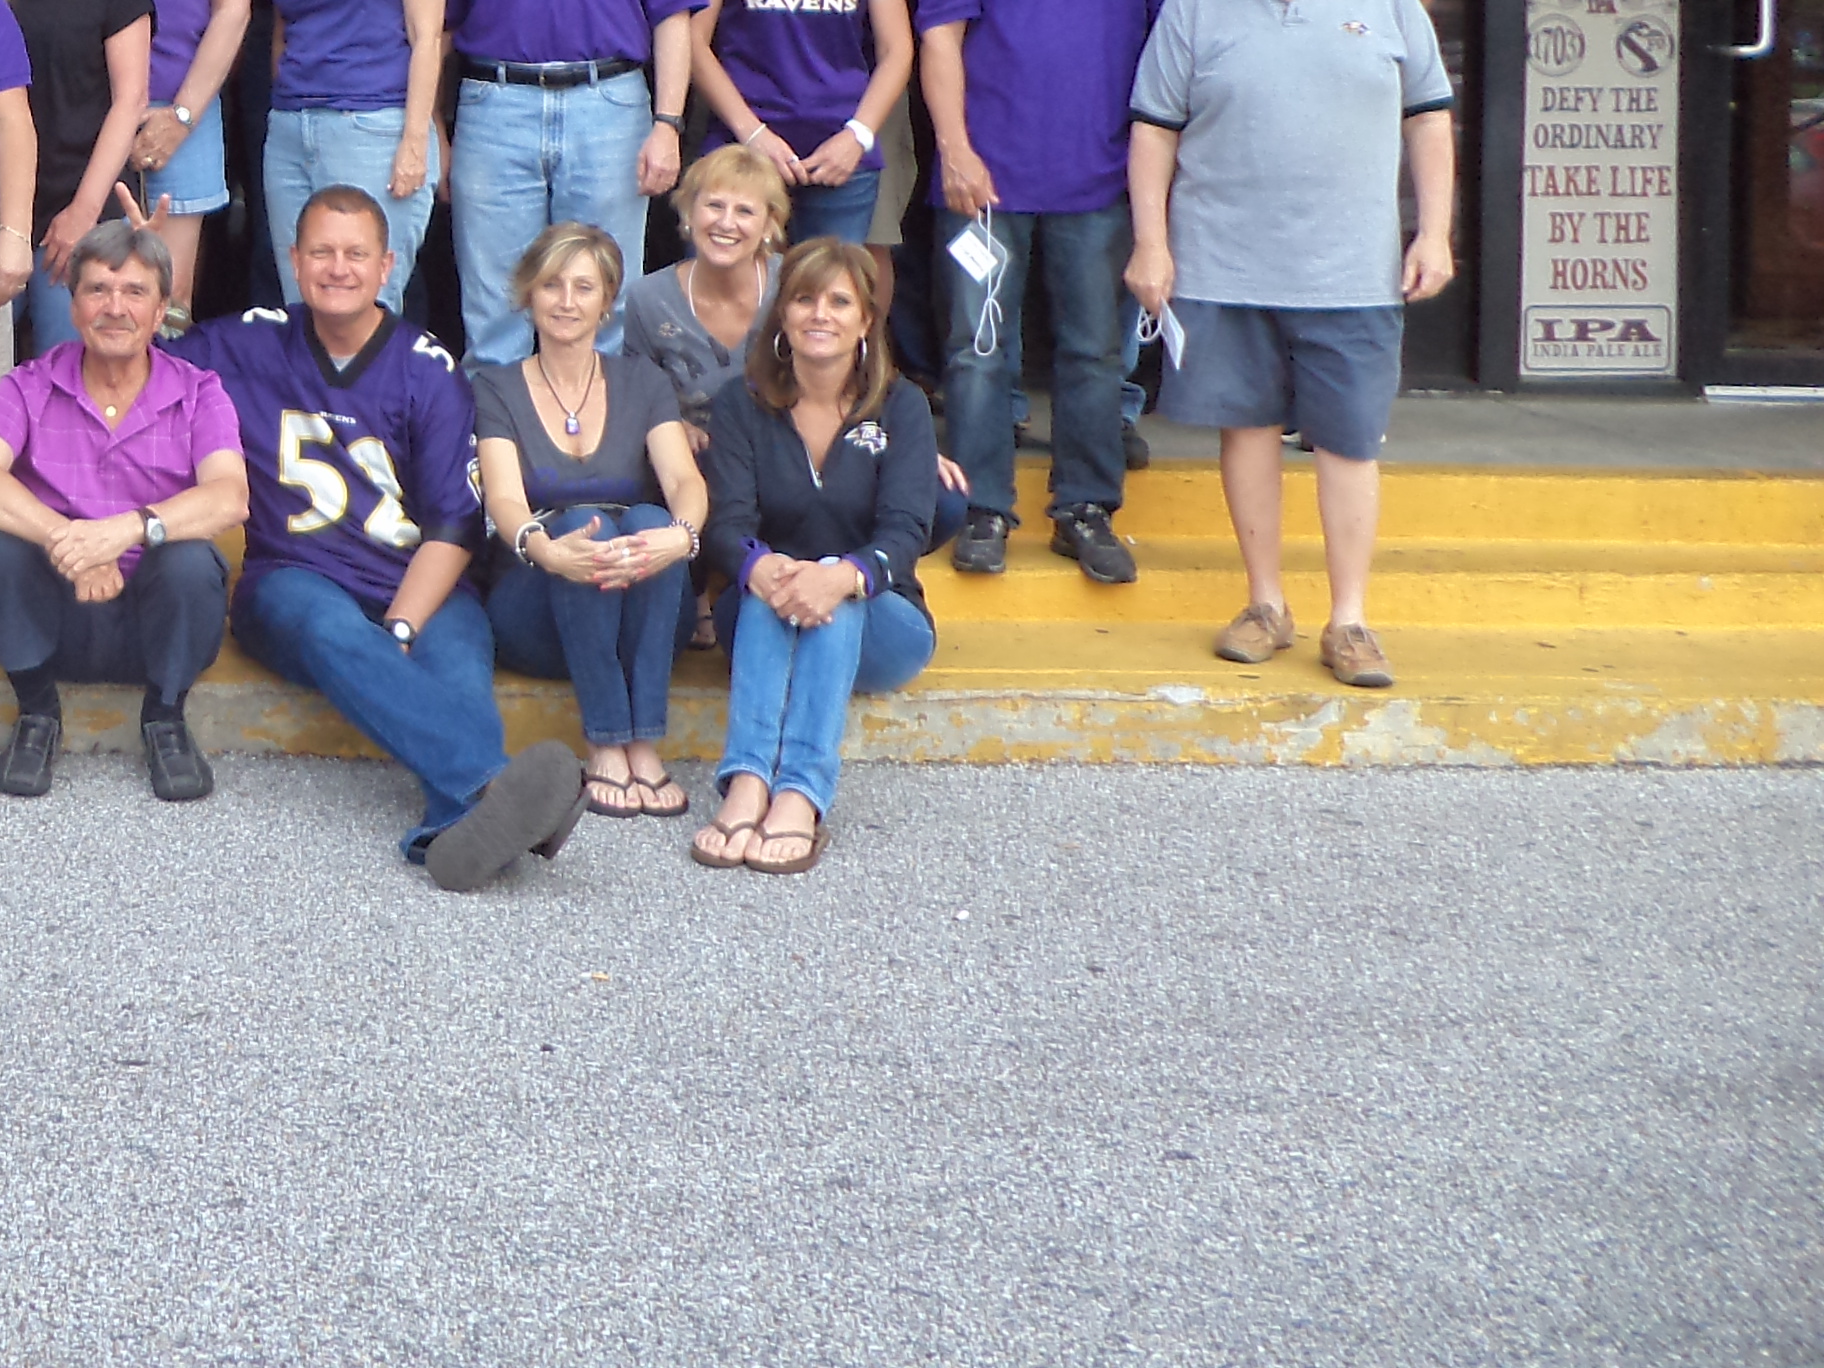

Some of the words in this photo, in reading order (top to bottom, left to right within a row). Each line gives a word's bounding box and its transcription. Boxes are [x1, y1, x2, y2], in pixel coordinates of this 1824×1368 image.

[1540, 87, 1604, 112] DEFY
[1610, 87, 1659, 112] THE
[1533, 123, 1664, 150] ORDINARY
[1524, 164, 1601, 197] TAKE
[1608, 165, 1672, 197] LIFE
[1548, 212, 1586, 243] BY
[1593, 212, 1651, 244] THE
[1549, 258, 1649, 291] HORNS
[1531, 318, 1663, 342] IPA
[1534, 343, 1579, 357] INDIA
[1586, 343, 1626, 357] PALE
[1632, 343, 1662, 357] ALE
[278, 409, 422, 547] 52
